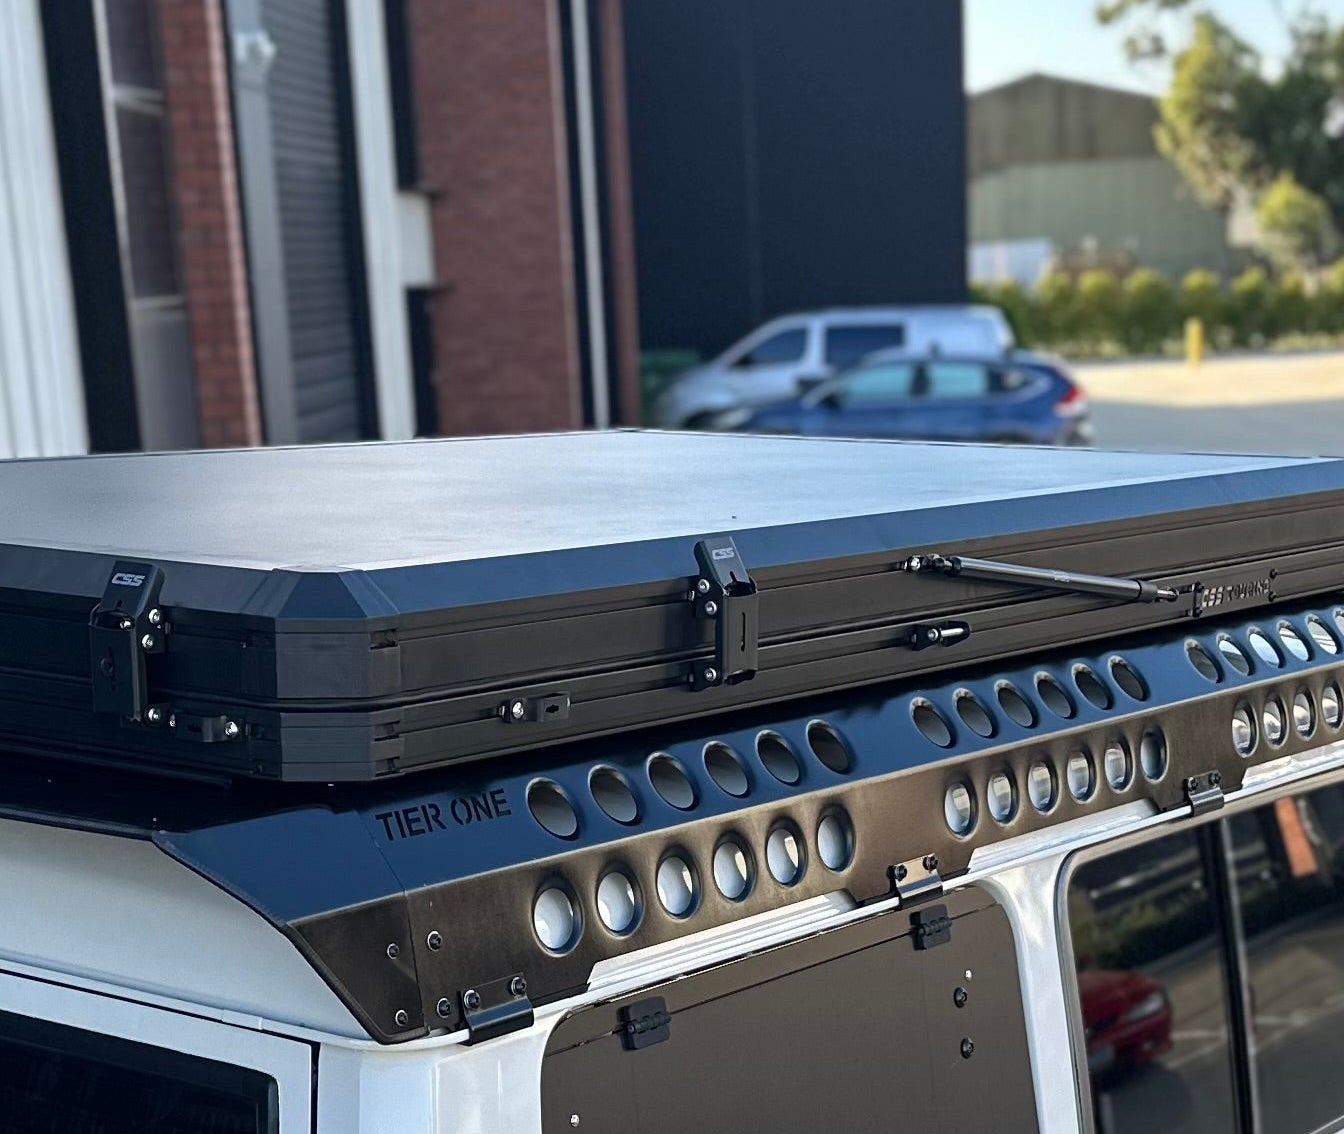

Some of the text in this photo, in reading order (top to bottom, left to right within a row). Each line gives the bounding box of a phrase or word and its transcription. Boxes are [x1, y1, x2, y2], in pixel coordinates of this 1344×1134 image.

[712, 547, 735, 560] CSS
[112, 573, 145, 586] CSS
[375, 788, 511, 841] TIER ONE
